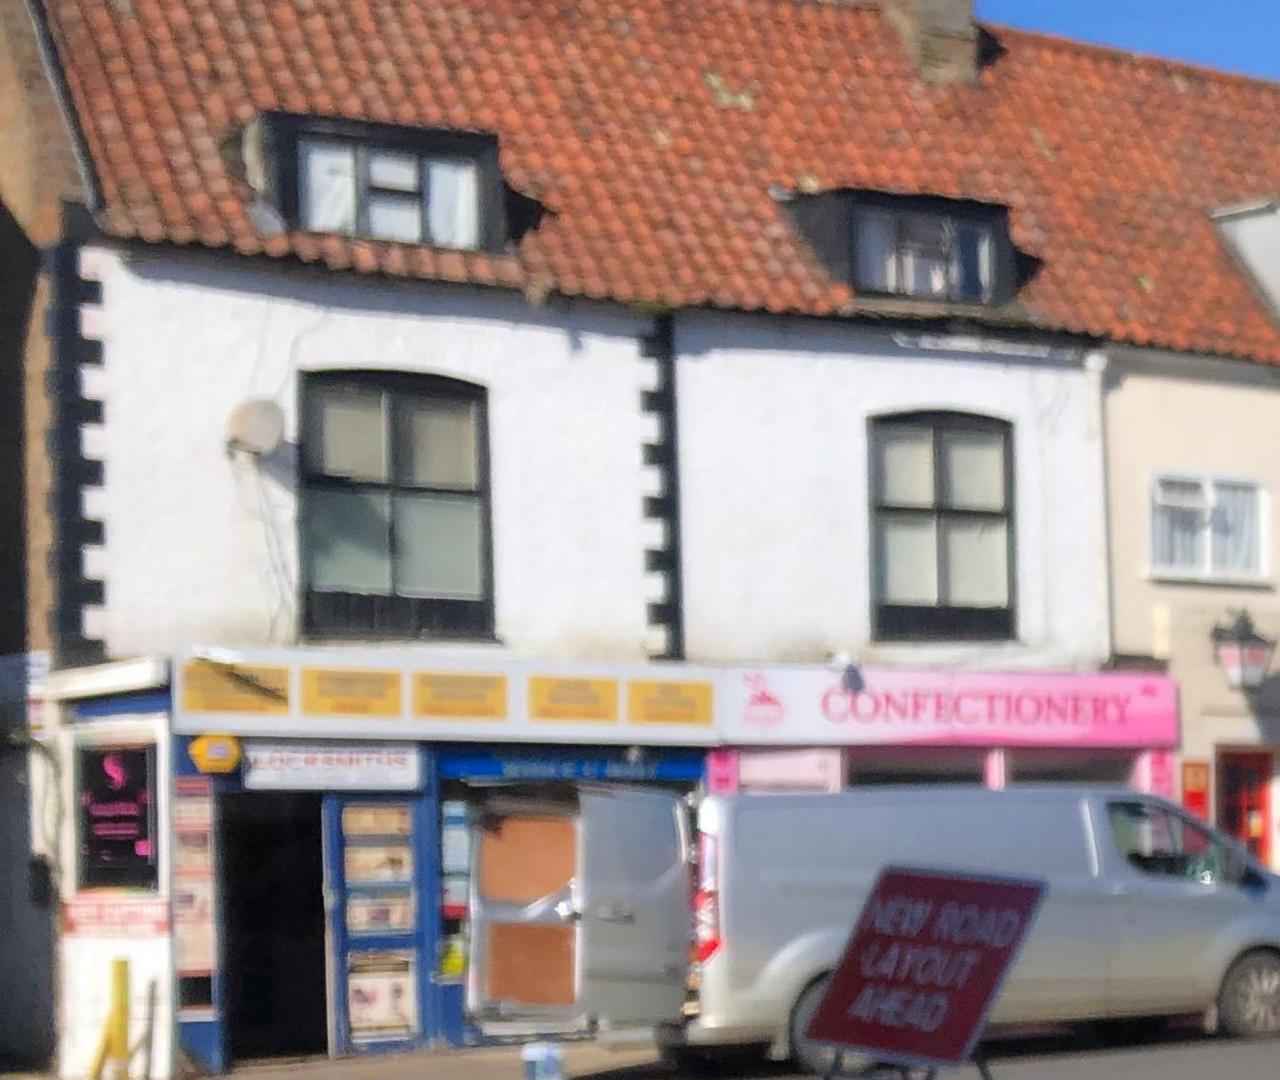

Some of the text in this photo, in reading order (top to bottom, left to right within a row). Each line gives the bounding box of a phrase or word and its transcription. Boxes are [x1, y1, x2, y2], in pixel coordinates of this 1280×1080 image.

[820, 689, 1132, 726] CONFECTIONERY
[869, 897, 1021, 949] NEW ROAD
[861, 941, 982, 990] LAYOUT
[847, 986, 950, 1033] AHEAD
